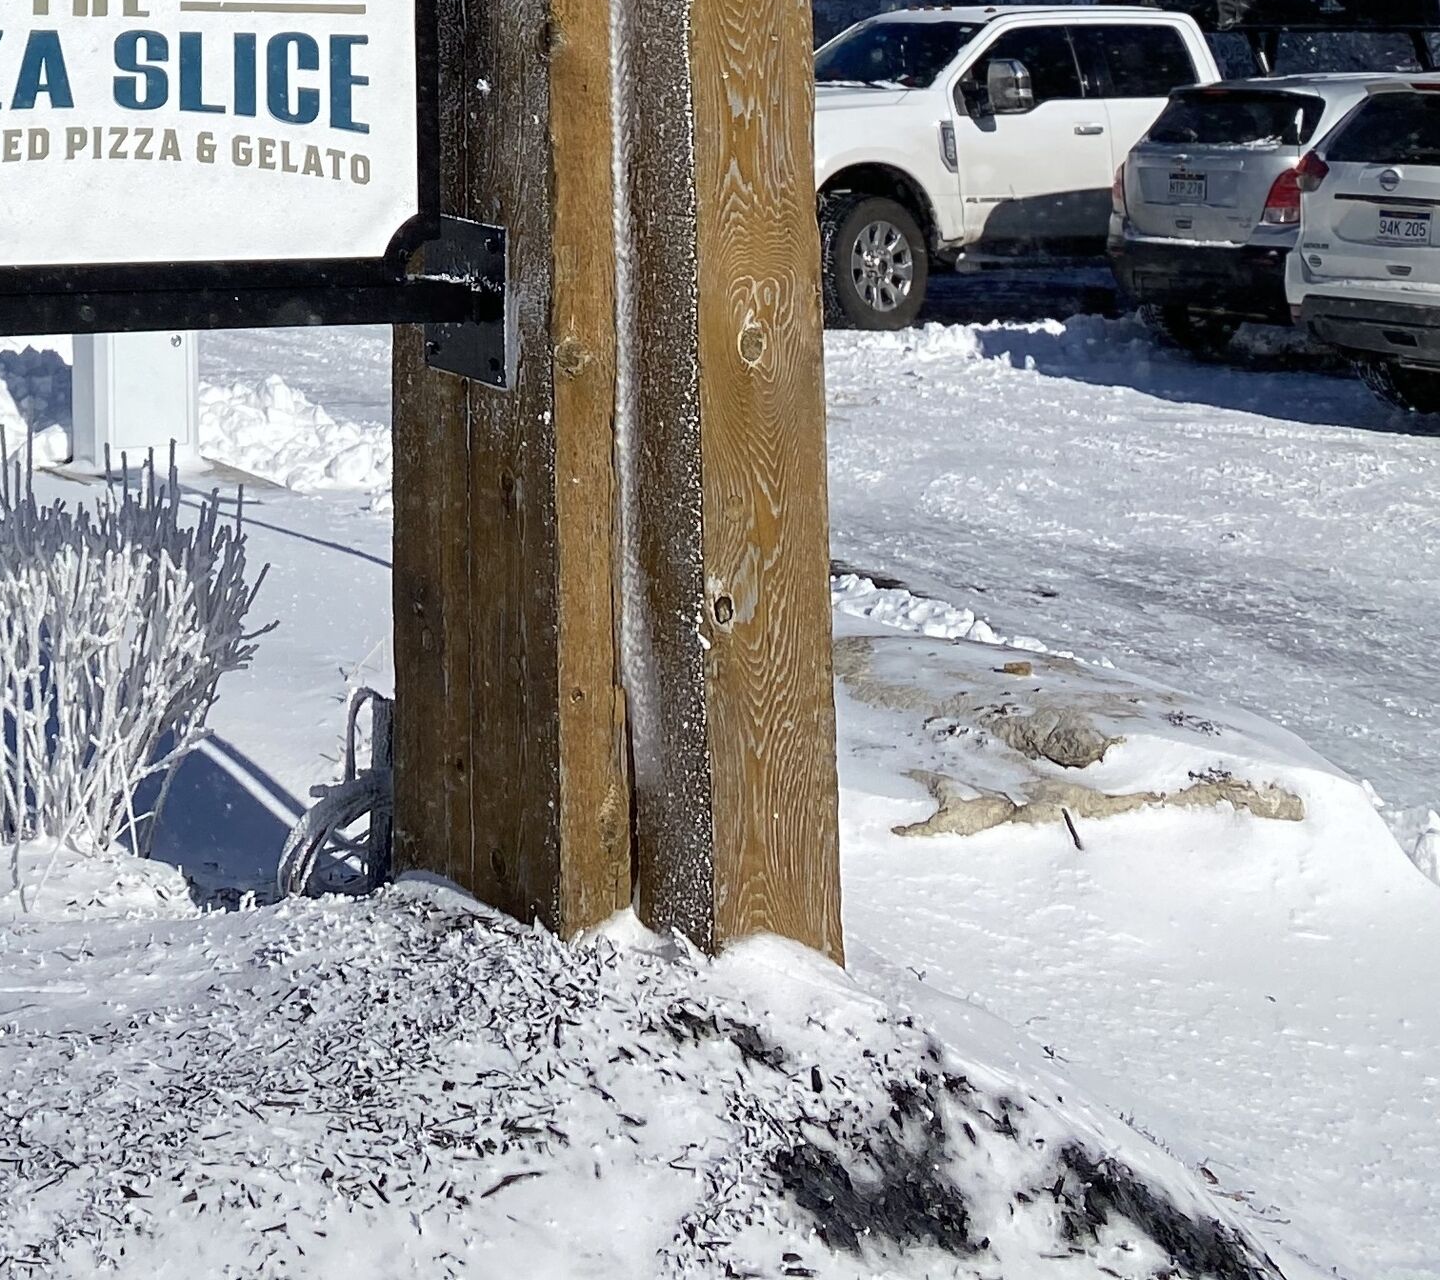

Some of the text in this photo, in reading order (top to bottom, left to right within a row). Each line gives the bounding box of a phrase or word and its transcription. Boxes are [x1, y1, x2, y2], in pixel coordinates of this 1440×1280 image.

[112, 29, 371, 135] SLICE
[65, 126, 182, 162] PIZZA
[196, 131, 218, 164] &
[231, 134, 372, 187] GELATO
[1379, 219, 1426, 237] 94K 205
